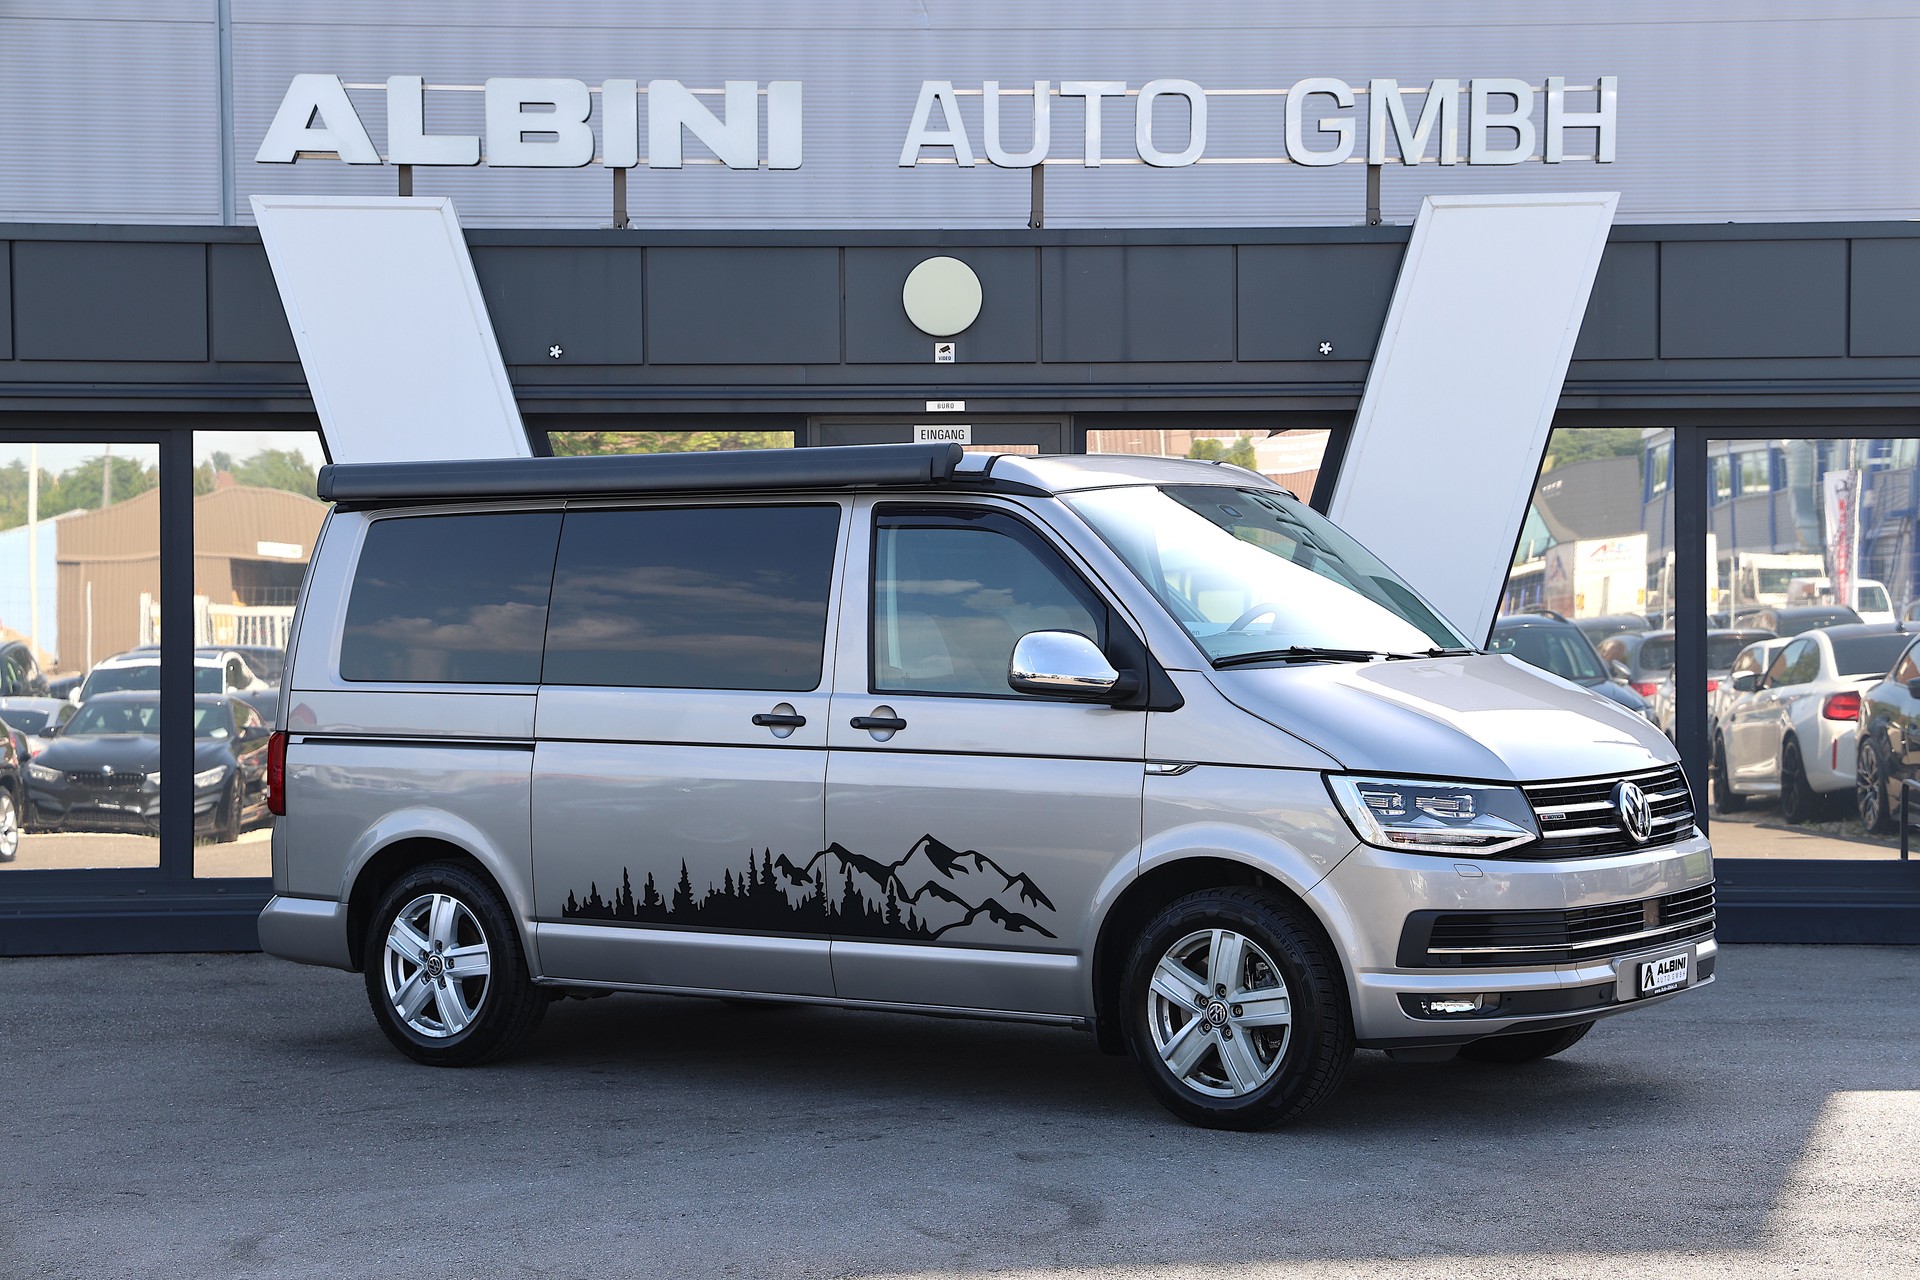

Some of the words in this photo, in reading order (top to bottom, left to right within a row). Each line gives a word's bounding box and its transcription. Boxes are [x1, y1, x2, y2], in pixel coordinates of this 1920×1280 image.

[255, 73, 802, 170] ALBINI
[898, 78, 1208, 169] AUTO
[1284, 75, 1619, 167] GMBH
[937, 402, 955, 410] BÜRO
[920, 429, 965, 440] EINGANG
[1657, 956, 1686, 976] ALBINI
[1657, 974, 1671, 984] AUTO
